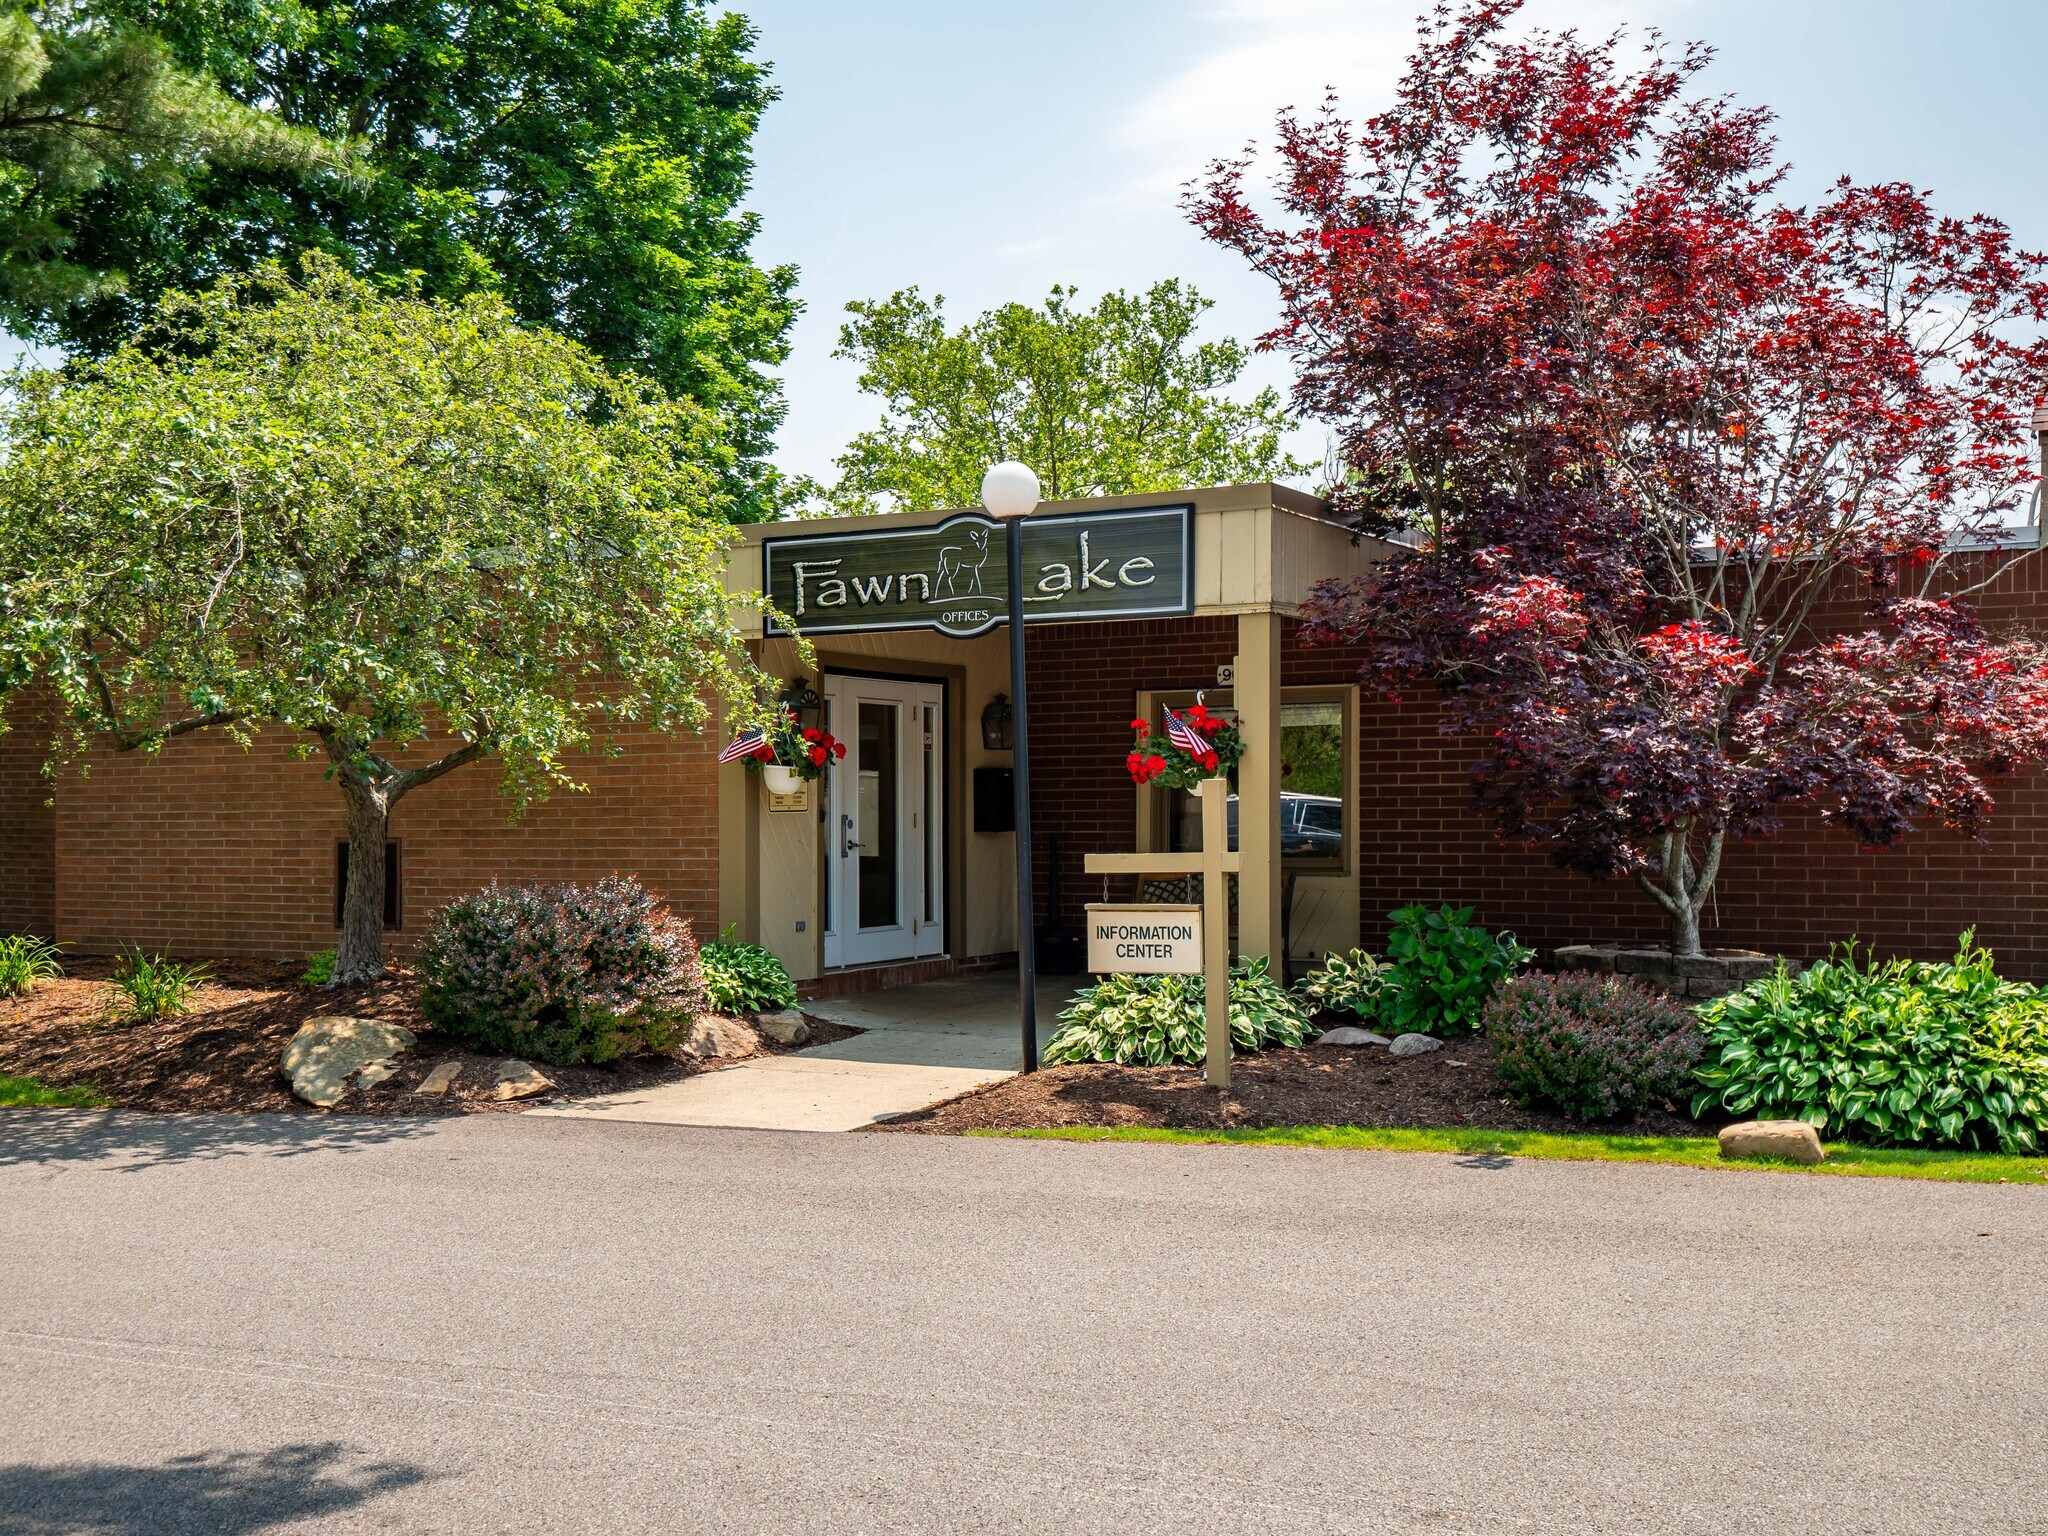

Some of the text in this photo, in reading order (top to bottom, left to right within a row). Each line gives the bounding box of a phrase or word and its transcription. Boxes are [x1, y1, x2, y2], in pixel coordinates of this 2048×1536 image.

[792, 530, 1156, 616] Fawn ake
[942, 610, 989, 623] OFFICES
[1096, 925, 1192, 940] INFORMATION
[1116, 944, 1173, 958] CENTER
